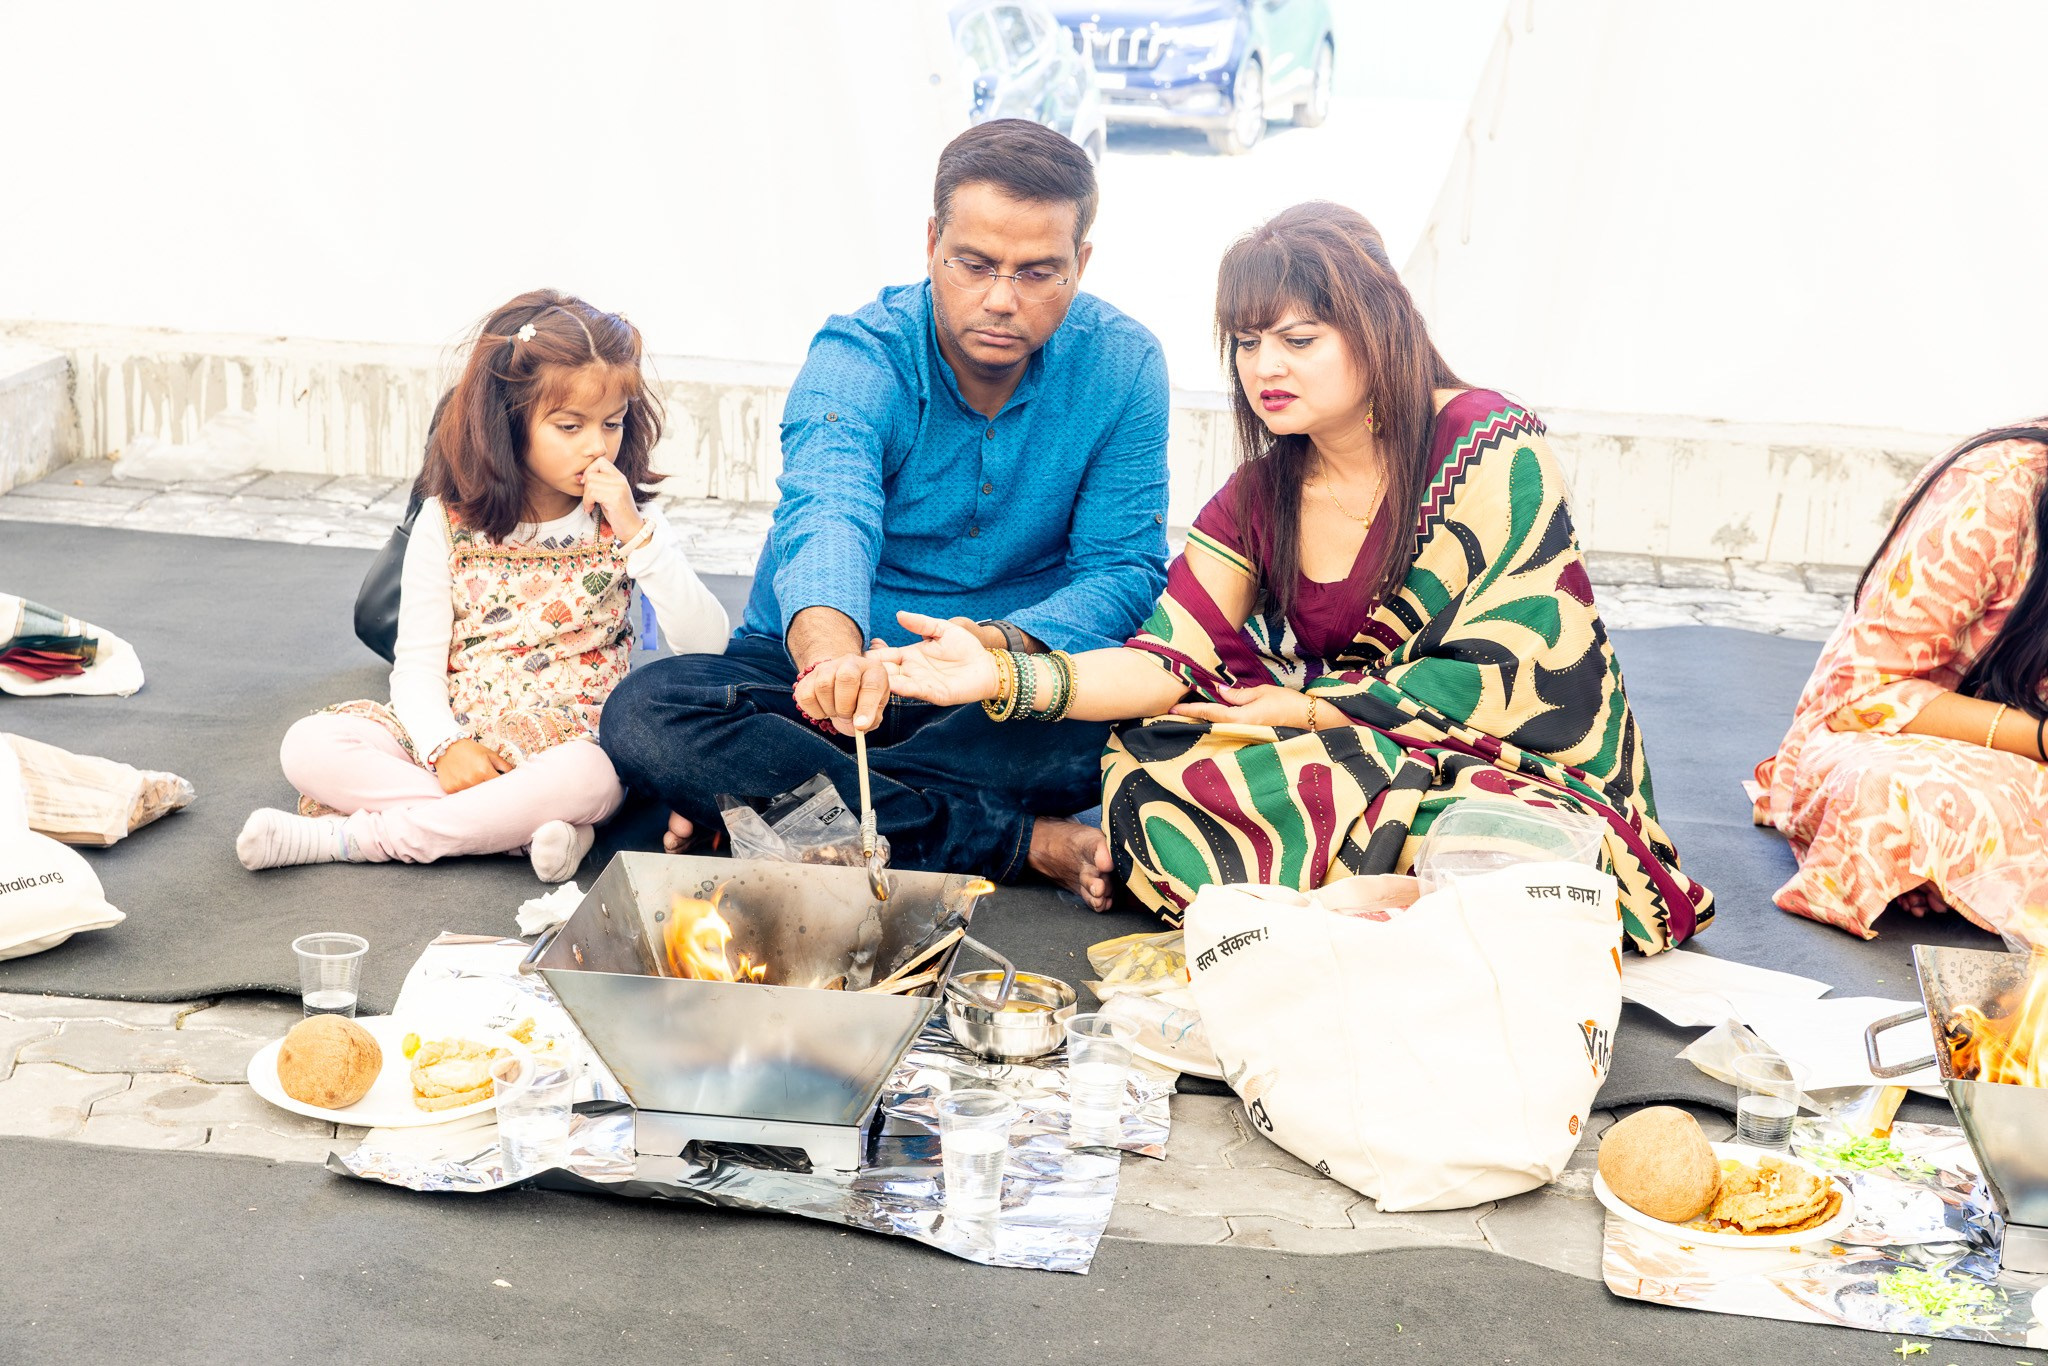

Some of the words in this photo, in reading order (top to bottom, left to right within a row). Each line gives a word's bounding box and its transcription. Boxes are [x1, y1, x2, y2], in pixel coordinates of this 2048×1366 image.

[822, 810, 841, 823] IKEA
[1525, 885, 1561, 899] सत्य
[1196, 947, 1218, 972] सत्य
[1577, 1022, 1611, 1076] Vih
